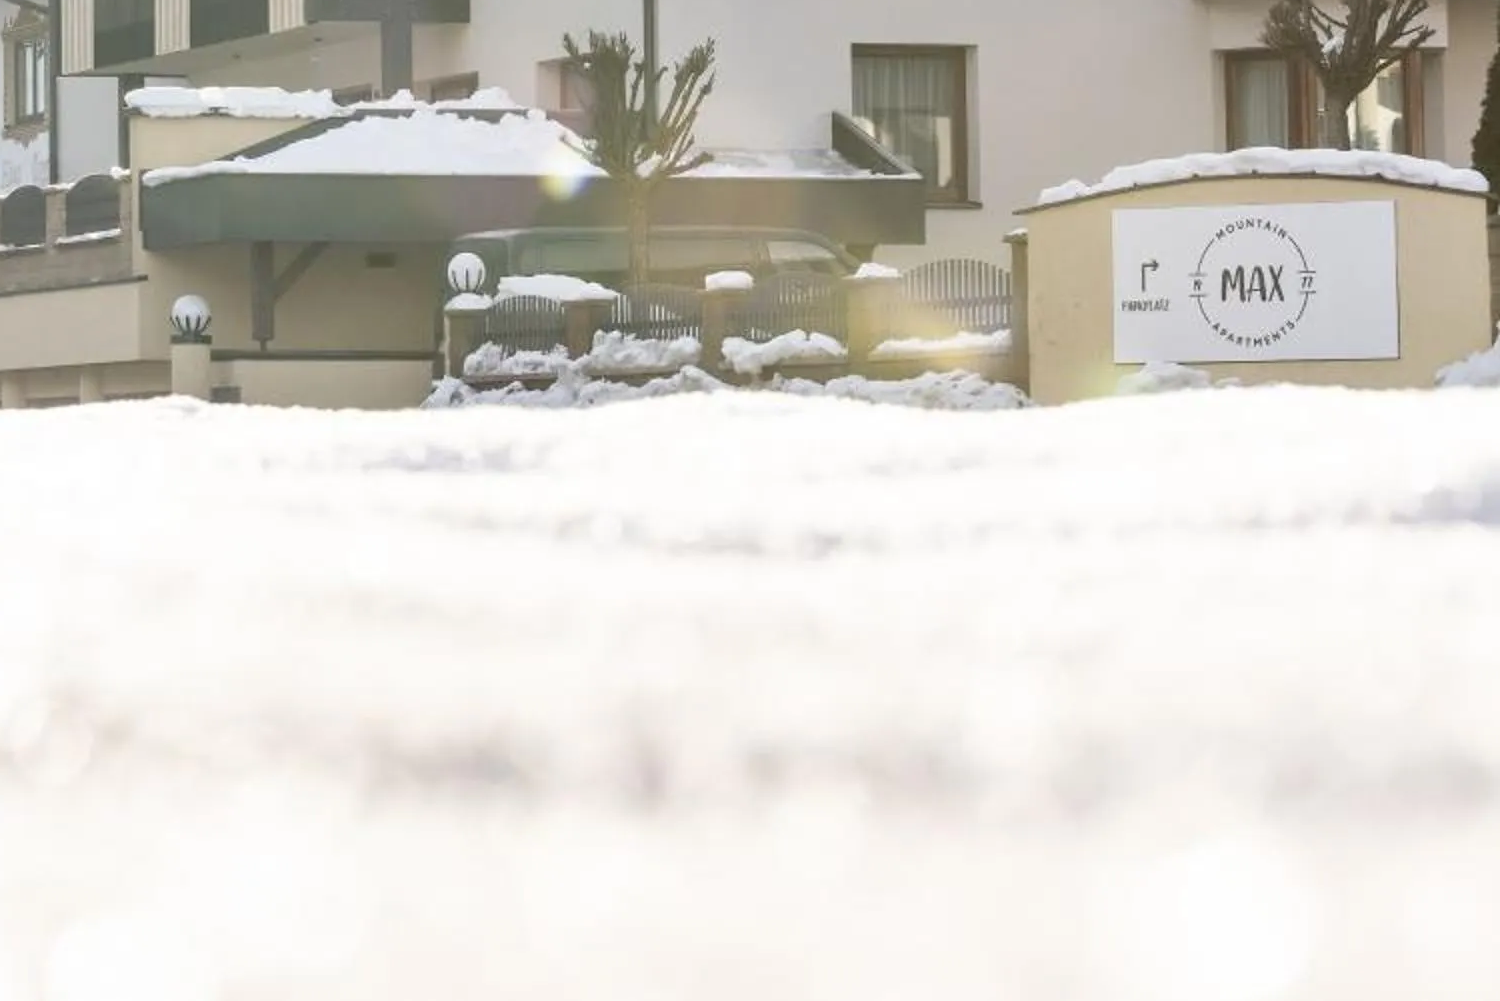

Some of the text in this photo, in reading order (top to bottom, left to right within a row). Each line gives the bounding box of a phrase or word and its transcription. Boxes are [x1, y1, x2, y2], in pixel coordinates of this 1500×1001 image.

[1215, 217, 1288, 240] MOUNTAIN
[1221, 264, 1285, 303] MAX
[1211, 319, 1296, 348] APARTMENTS
